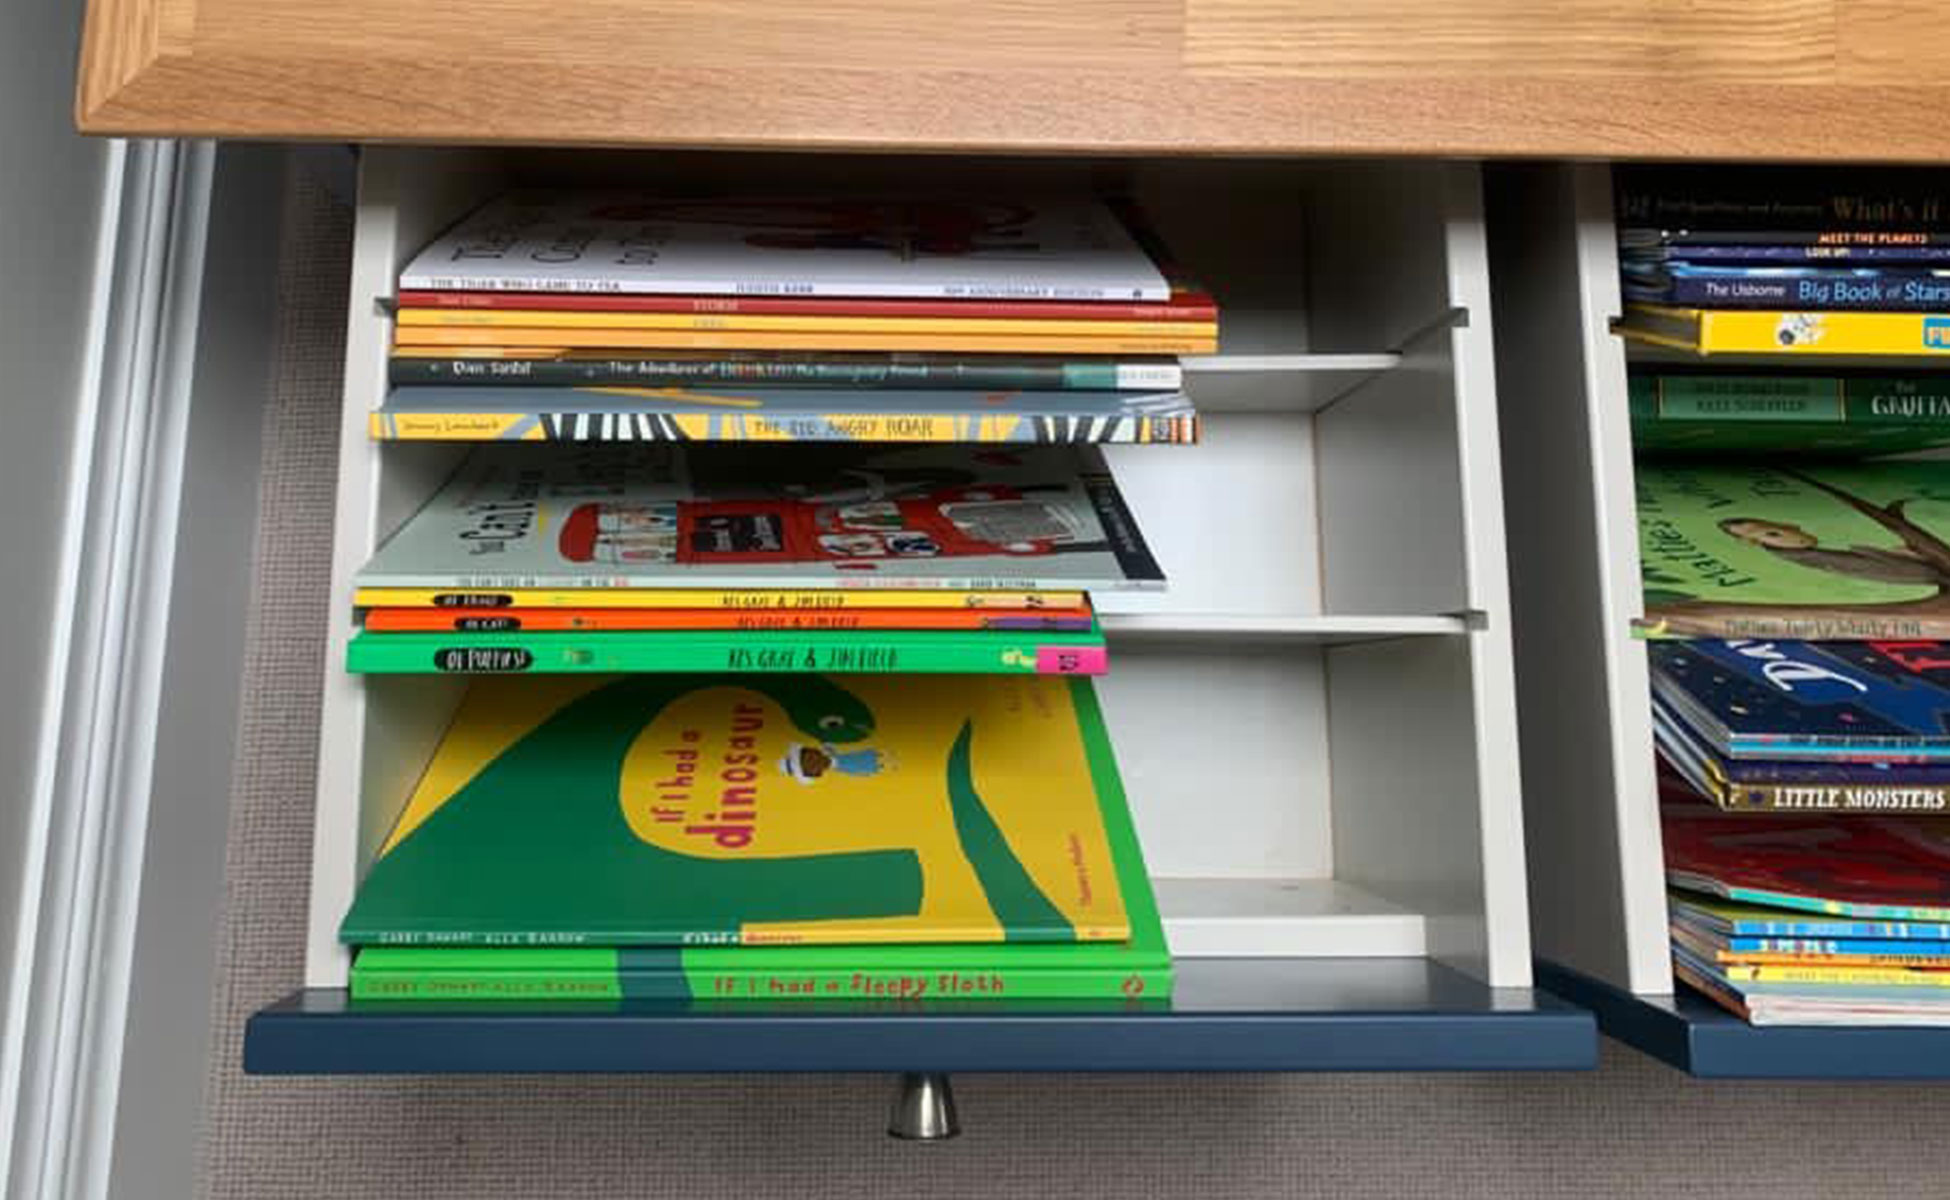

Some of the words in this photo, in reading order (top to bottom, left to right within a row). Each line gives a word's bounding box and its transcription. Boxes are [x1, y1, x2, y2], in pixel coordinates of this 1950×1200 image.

[1819, 232, 1850, 243] MEET
[1854, 232, 1875, 244] THE
[1879, 232, 1928, 244] PLANETS
[1705, 282, 1727, 296] The
[1731, 282, 1787, 297] Usborne
[1799, 281, 1829, 302] Big
[1834, 281, 1883, 301] Book
[452, 361, 485, 375] Dan
[609, 362, 633, 374] The
[754, 420, 781, 434] THE
[886, 418, 934, 436] ROAR
[446, 649, 462, 669] OI
[804, 647, 816, 669] &
[682, 729, 701, 743] a
[655, 750, 698, 788] had
[684, 703, 764, 848] dinosaur
[660, 792, 690, 800] I
[1773, 788, 1842, 808] LITTLE
[1844, 789, 1946, 809] MONSTERS
[651, 806, 685, 823] If
[715, 976, 734, 994] If
[770, 977, 815, 994] had
[825, 981, 840, 993] a
